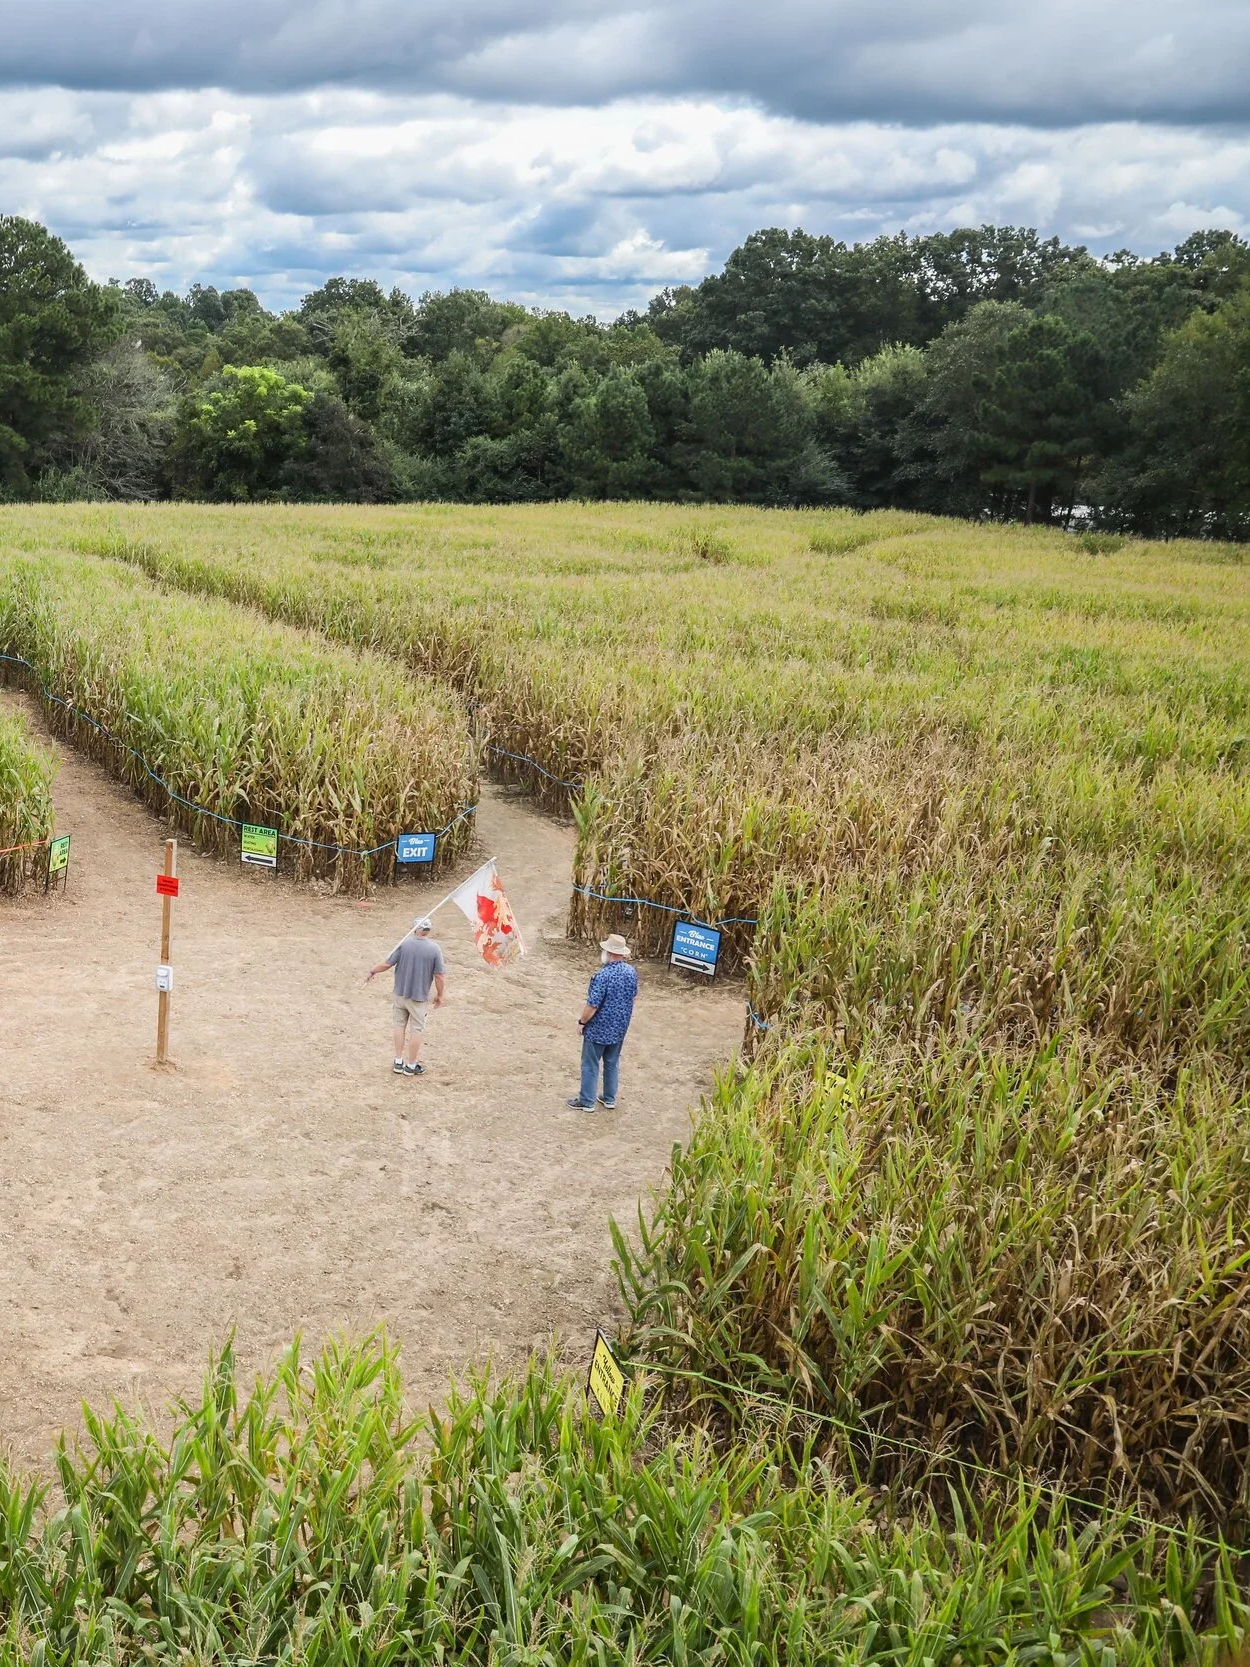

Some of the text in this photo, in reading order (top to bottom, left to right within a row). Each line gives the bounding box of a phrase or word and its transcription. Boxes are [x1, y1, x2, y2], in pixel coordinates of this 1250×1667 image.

[402, 847, 428, 858] EXIT
[688, 930, 705, 940] Blue
[676, 935, 715, 951] ENTRANCE
[602, 1354, 616, 1384] Yellow
